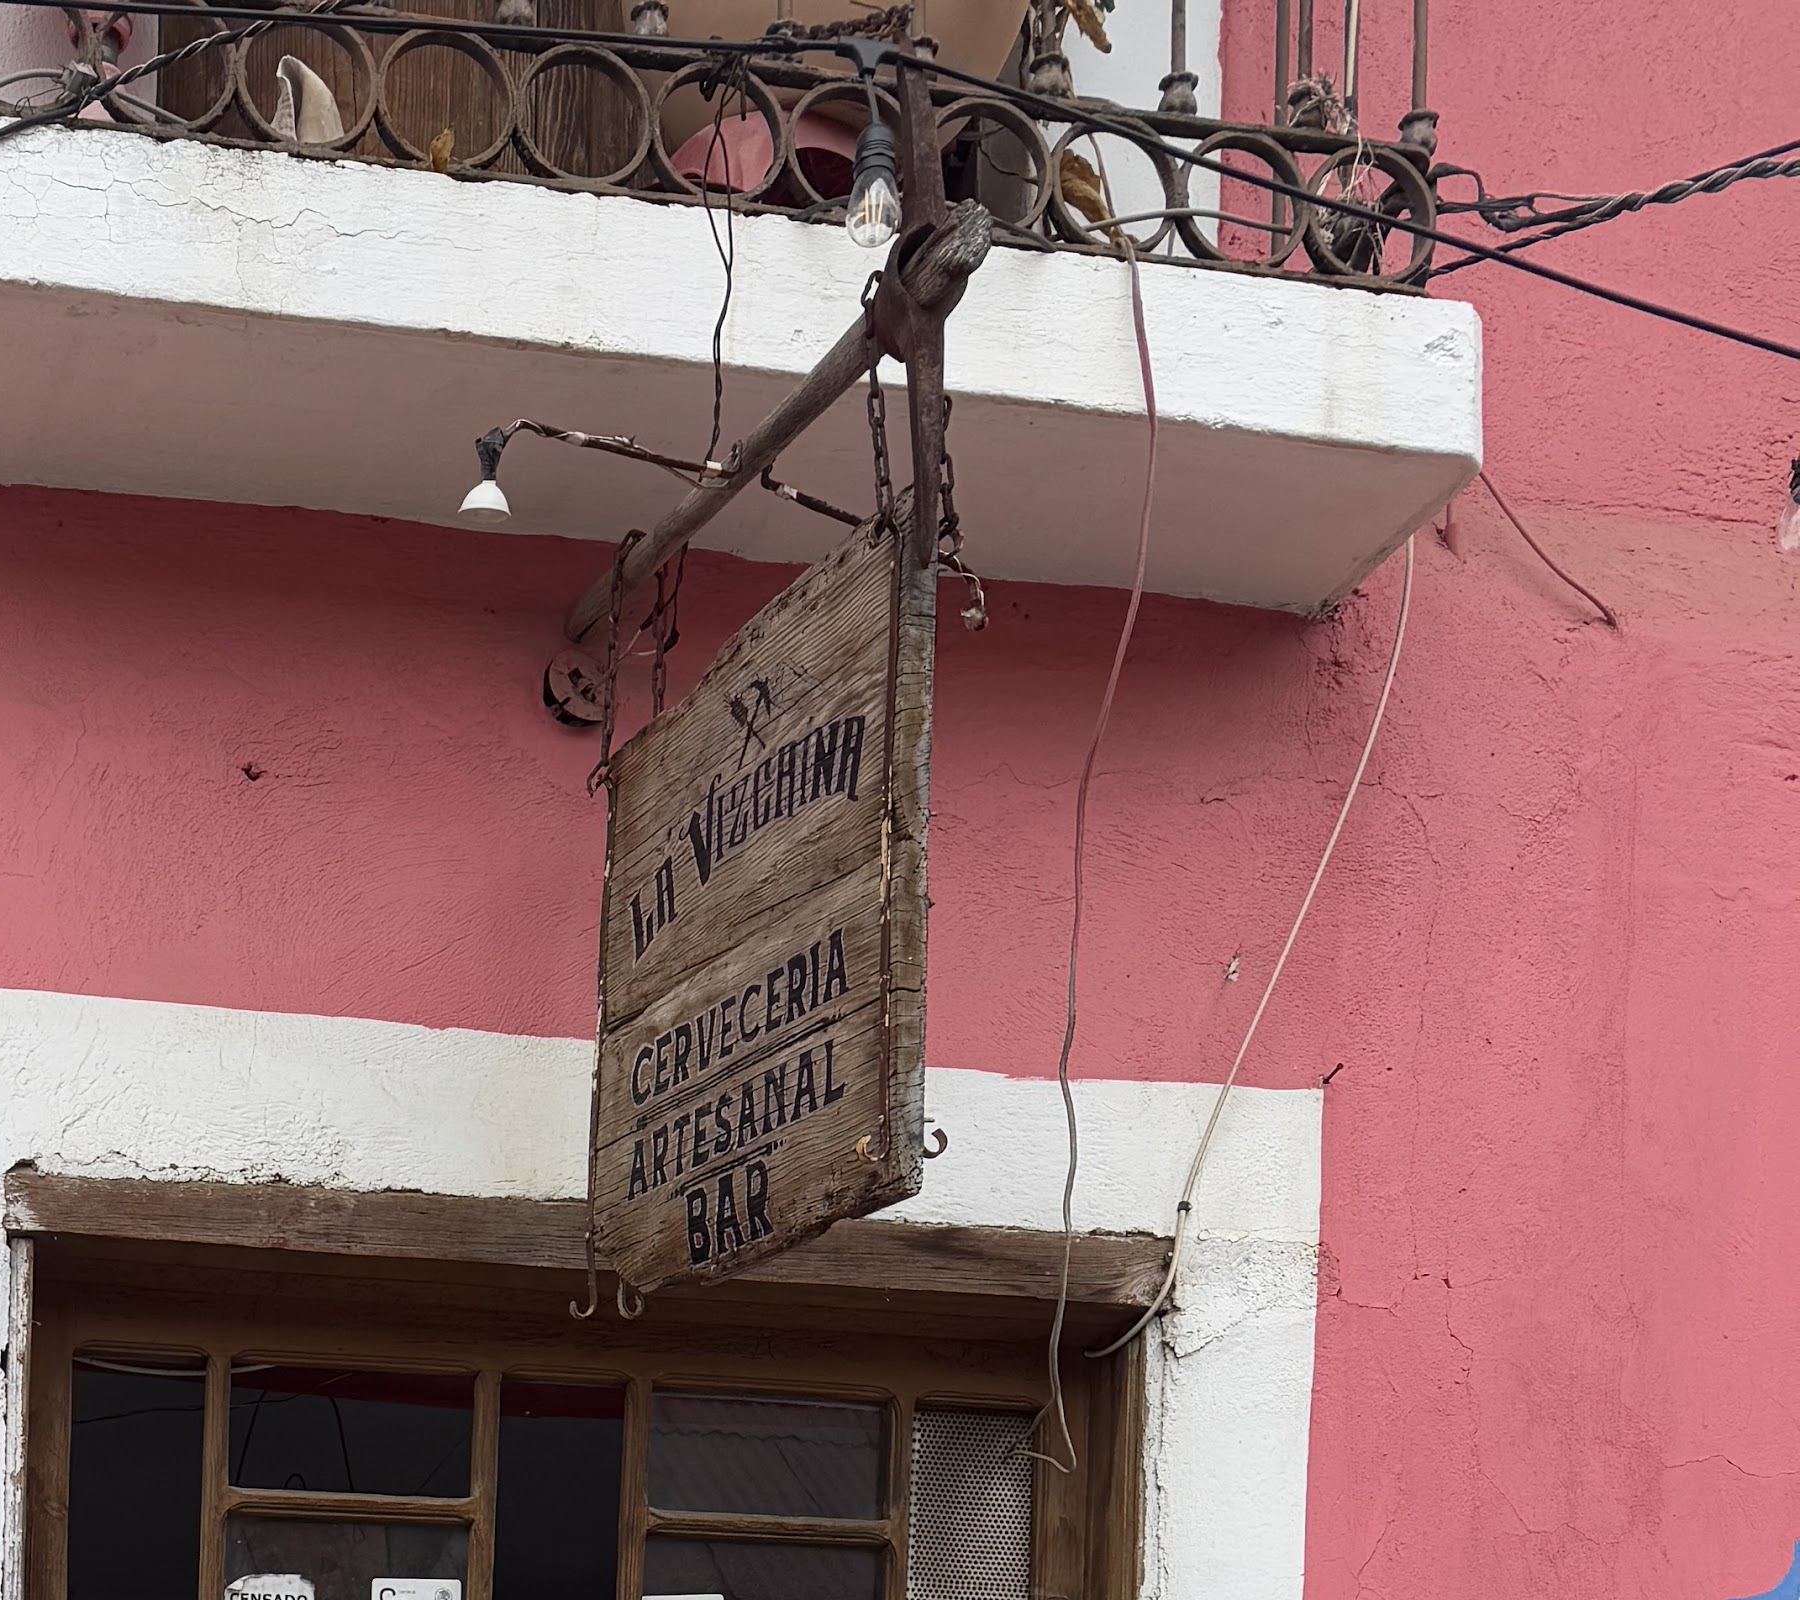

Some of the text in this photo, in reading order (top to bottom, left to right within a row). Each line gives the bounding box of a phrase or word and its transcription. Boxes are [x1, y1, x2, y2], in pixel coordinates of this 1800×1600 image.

[630, 855, 678, 966] LA
[631, 928, 850, 1106] CERVECERIA
[627, 1040, 845, 1200] ARTESANAL
[685, 1160, 774, 1265] BAR
